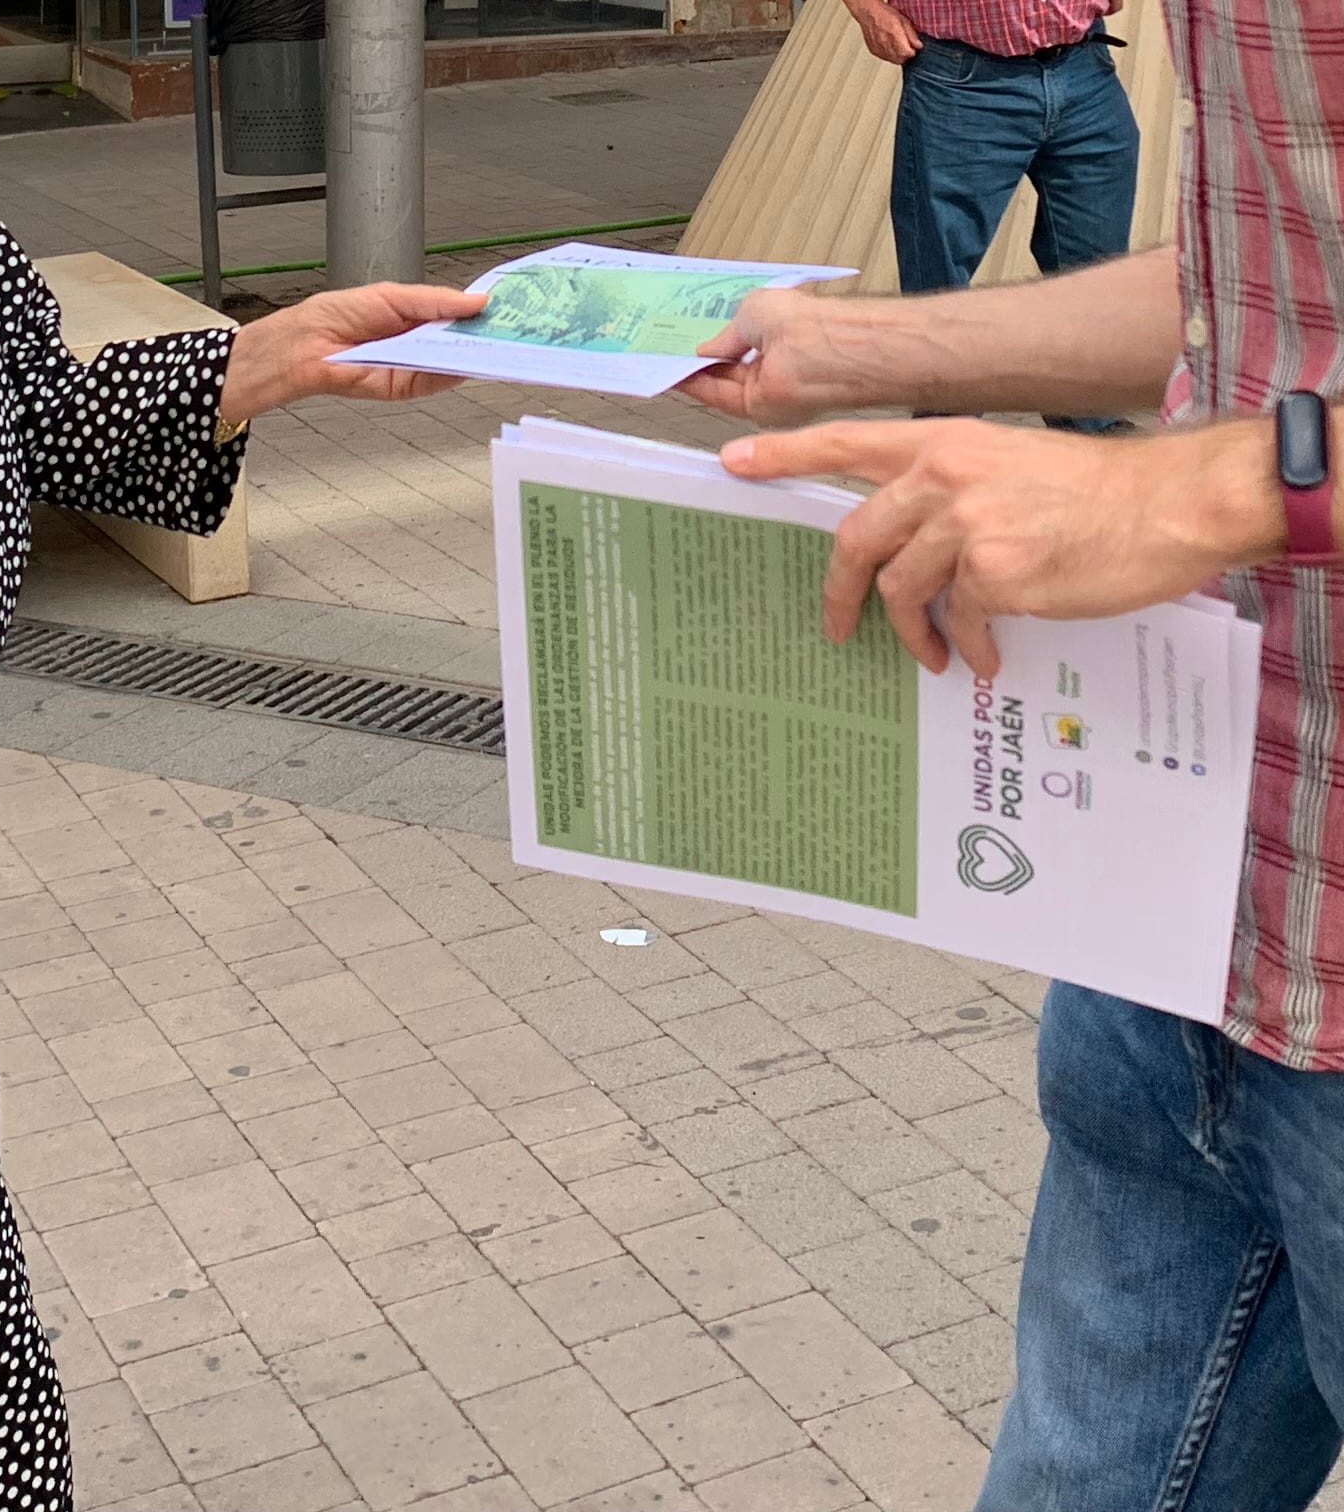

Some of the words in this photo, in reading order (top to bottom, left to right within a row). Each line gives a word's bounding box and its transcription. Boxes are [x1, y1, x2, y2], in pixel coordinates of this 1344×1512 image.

[973, 677, 993, 724] POD
[996, 696, 1023, 763] JAÉN
[538, 710, 552, 781] PODEMOS
[974, 729, 993, 813] UNIDAS
[543, 783, 556, 836] UNIDAS
[1000, 768, 1022, 820] POR
